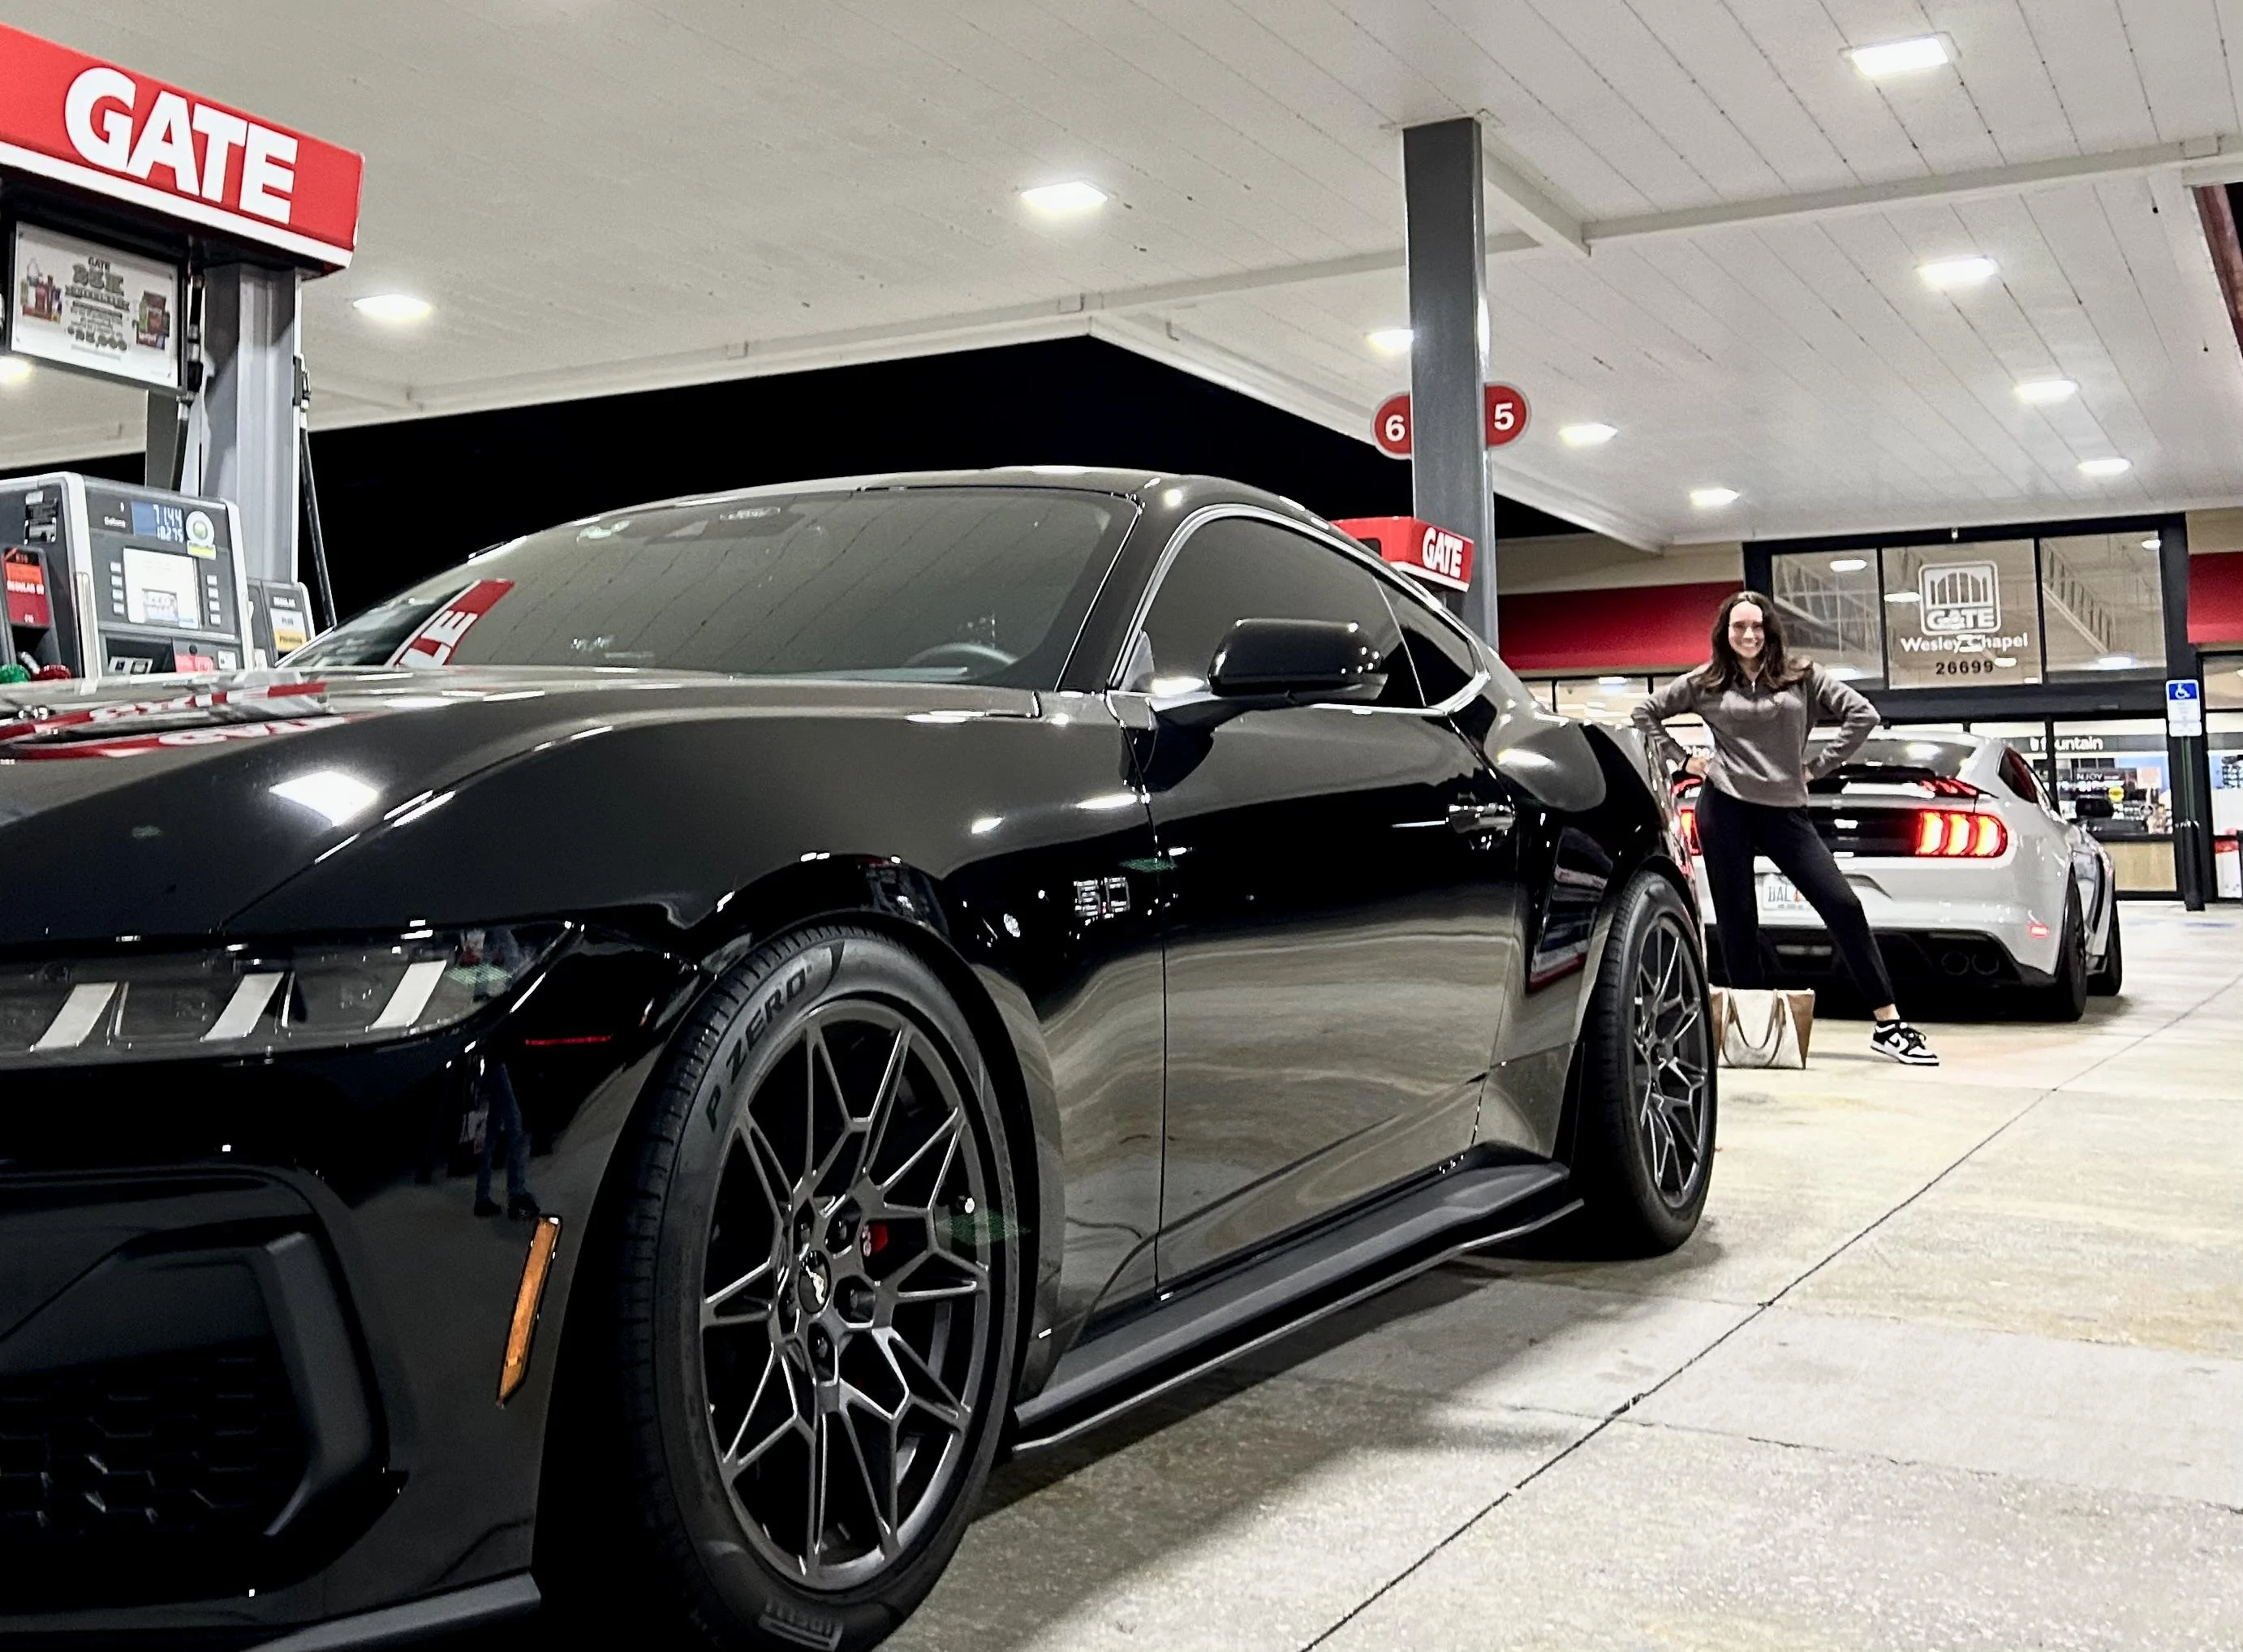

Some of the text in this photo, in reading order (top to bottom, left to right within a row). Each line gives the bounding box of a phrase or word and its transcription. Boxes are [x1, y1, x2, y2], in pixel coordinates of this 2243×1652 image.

[65, 67, 299, 226] GATE
[1384, 415, 1406, 442] 6
[1494, 402, 1514, 430] 5
[1423, 527, 1463, 579] GATE
[1927, 609, 1995, 630] GATE
[1901, 636, 1961, 653] Wesley
[1935, 660, 1994, 675] 26699
[2040, 736, 2103, 751] funtain
[706, 968, 807, 1134] P ZERO
